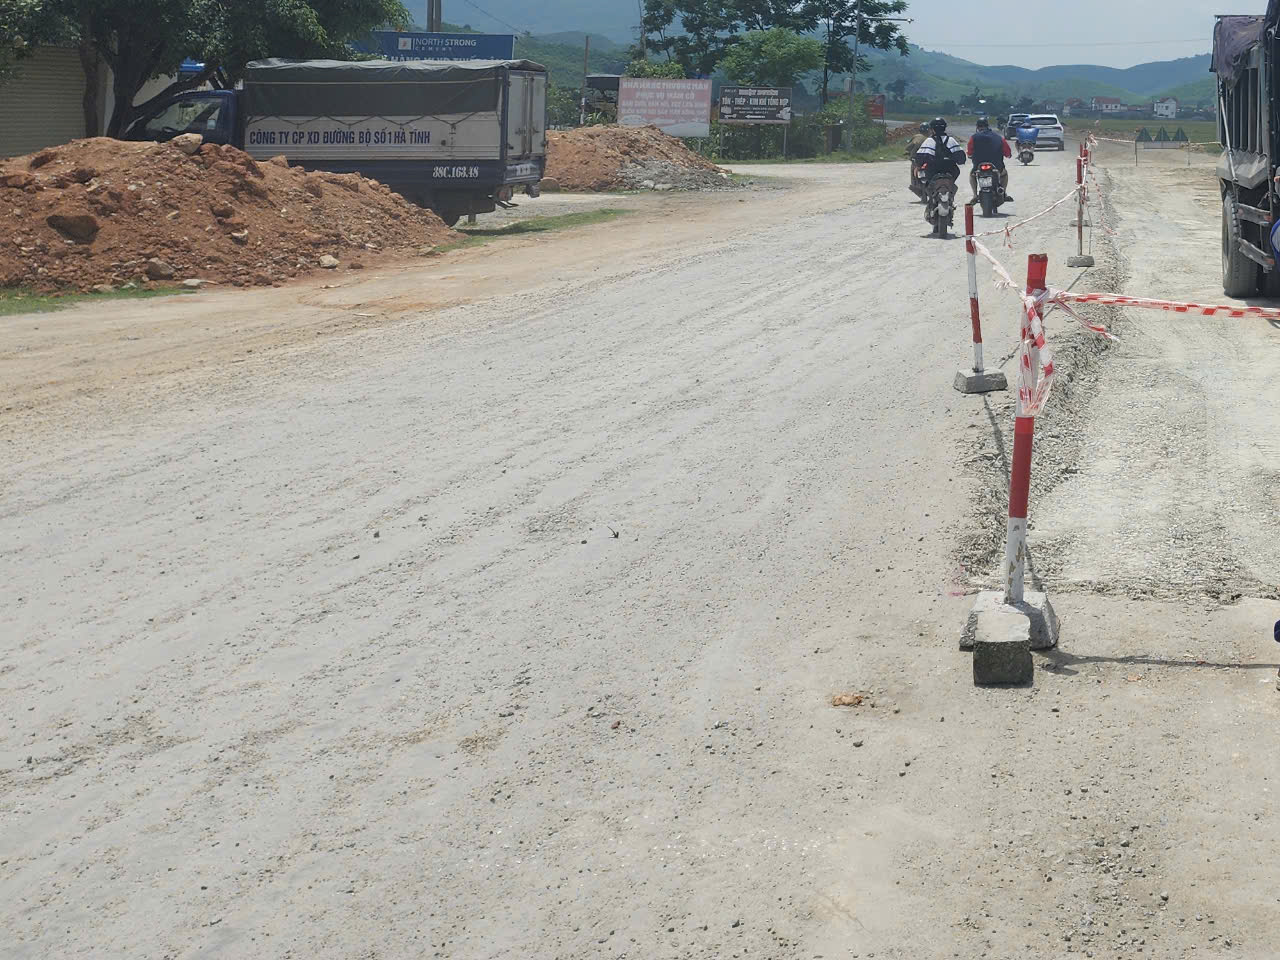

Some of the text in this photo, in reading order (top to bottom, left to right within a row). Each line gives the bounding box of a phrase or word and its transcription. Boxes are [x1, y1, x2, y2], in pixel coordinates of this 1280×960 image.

[416, 38, 444, 46] NORTH
[250, 129, 276, 144] CÔNG
[278, 131, 289, 144] TY
[292, 131, 304, 144] CP
[307, 131, 320, 144] XD
[322, 128, 354, 144] ĐƯỜNG
[359, 128, 371, 146] BỘ
[394, 128, 406, 144] HÀ
[410, 128, 430, 144] TĨNH
